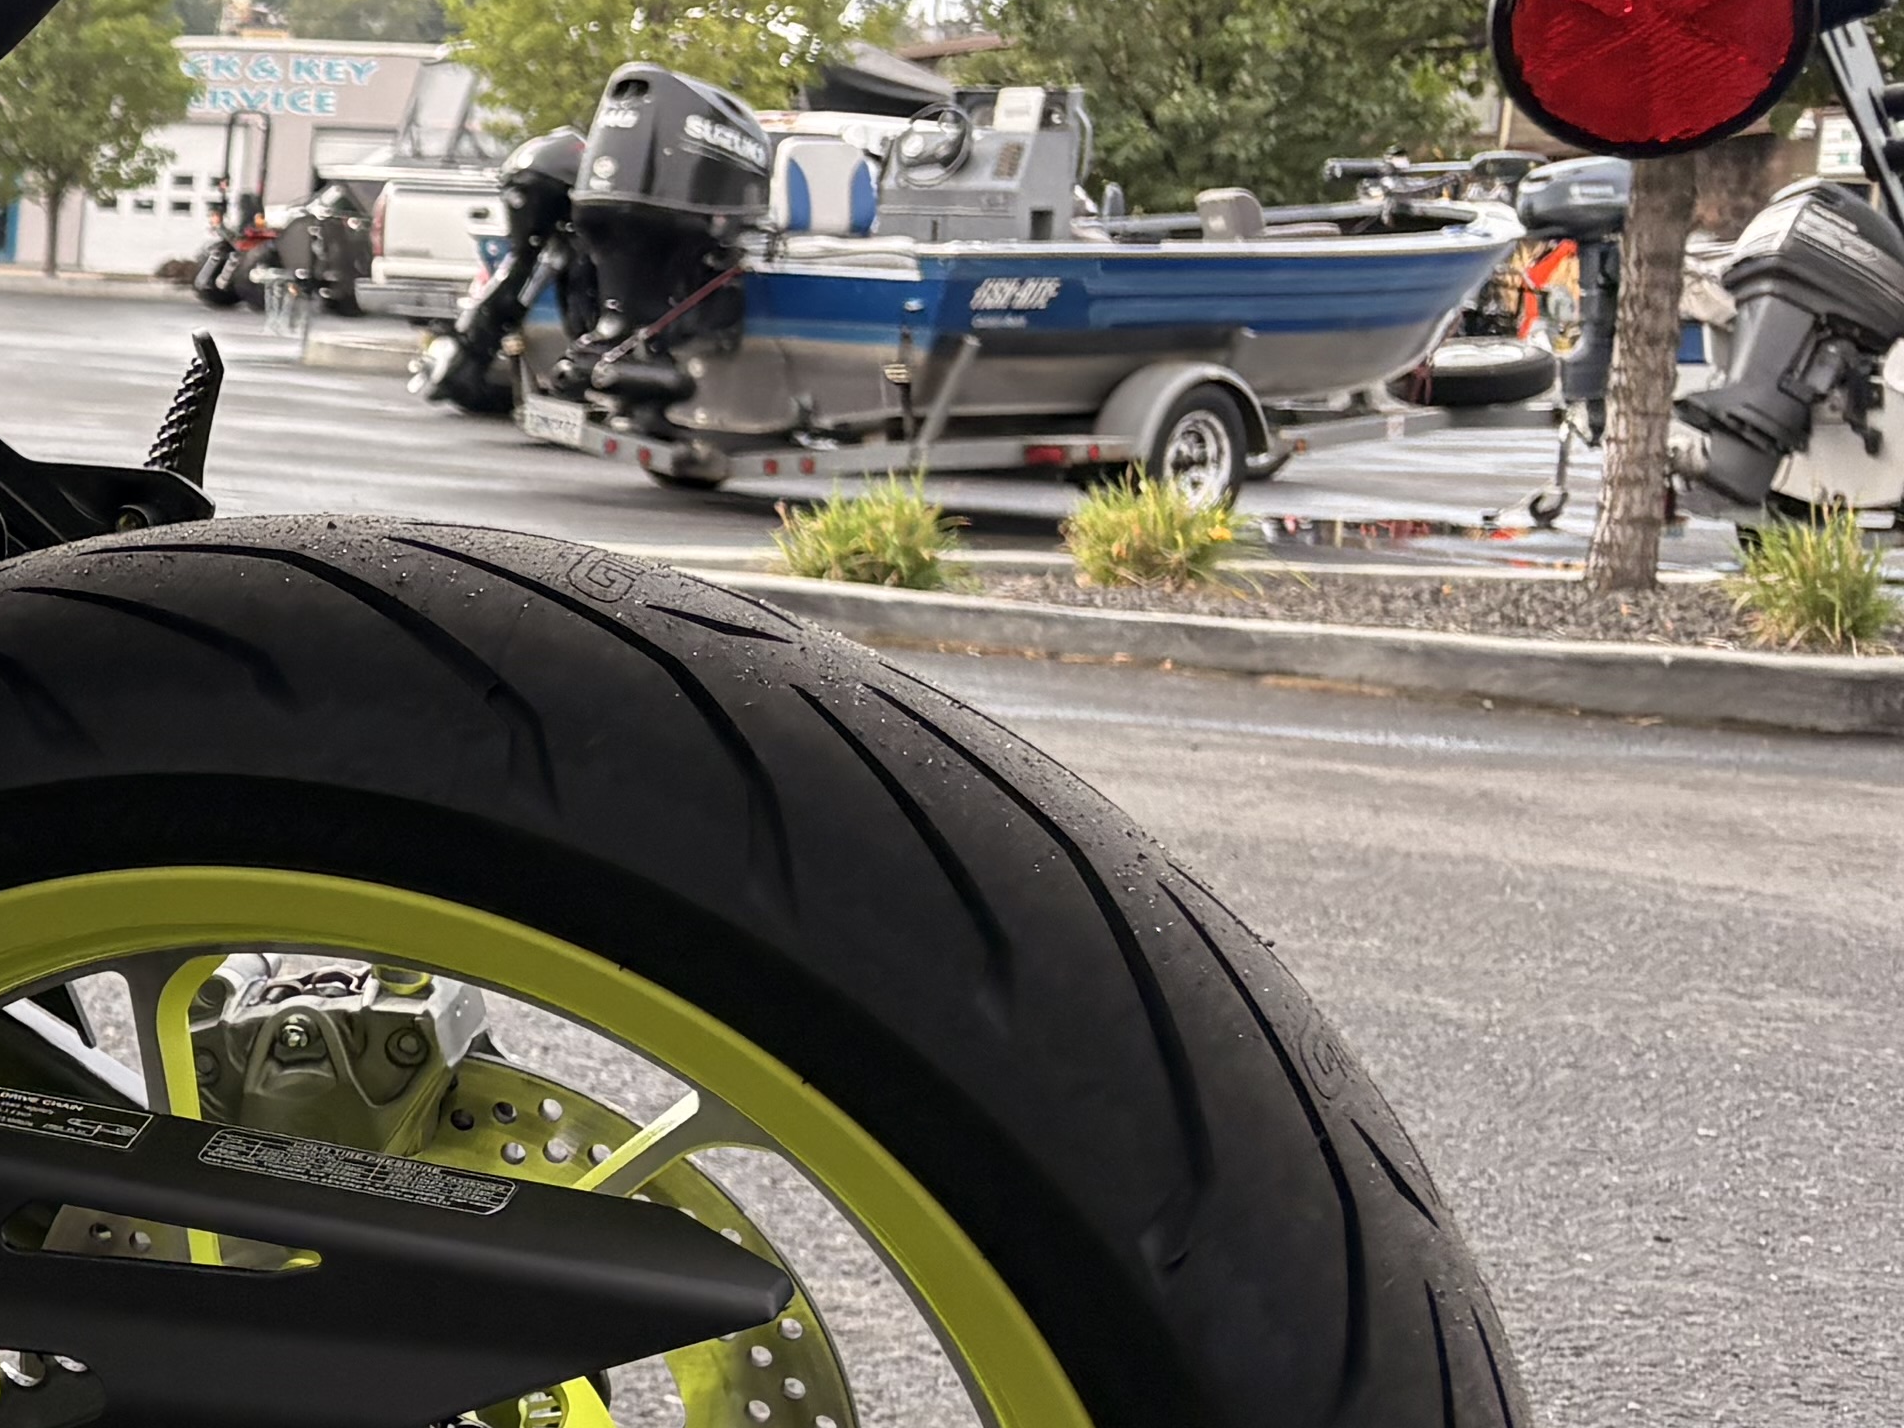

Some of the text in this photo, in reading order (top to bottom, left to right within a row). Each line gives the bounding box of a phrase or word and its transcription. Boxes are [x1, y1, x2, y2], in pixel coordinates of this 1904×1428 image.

[246, 53, 282, 82] &
[290, 56, 378, 85] KEY
[189, 86, 337, 116] RVICE
[42, 1099, 84, 1112] CHAIN
